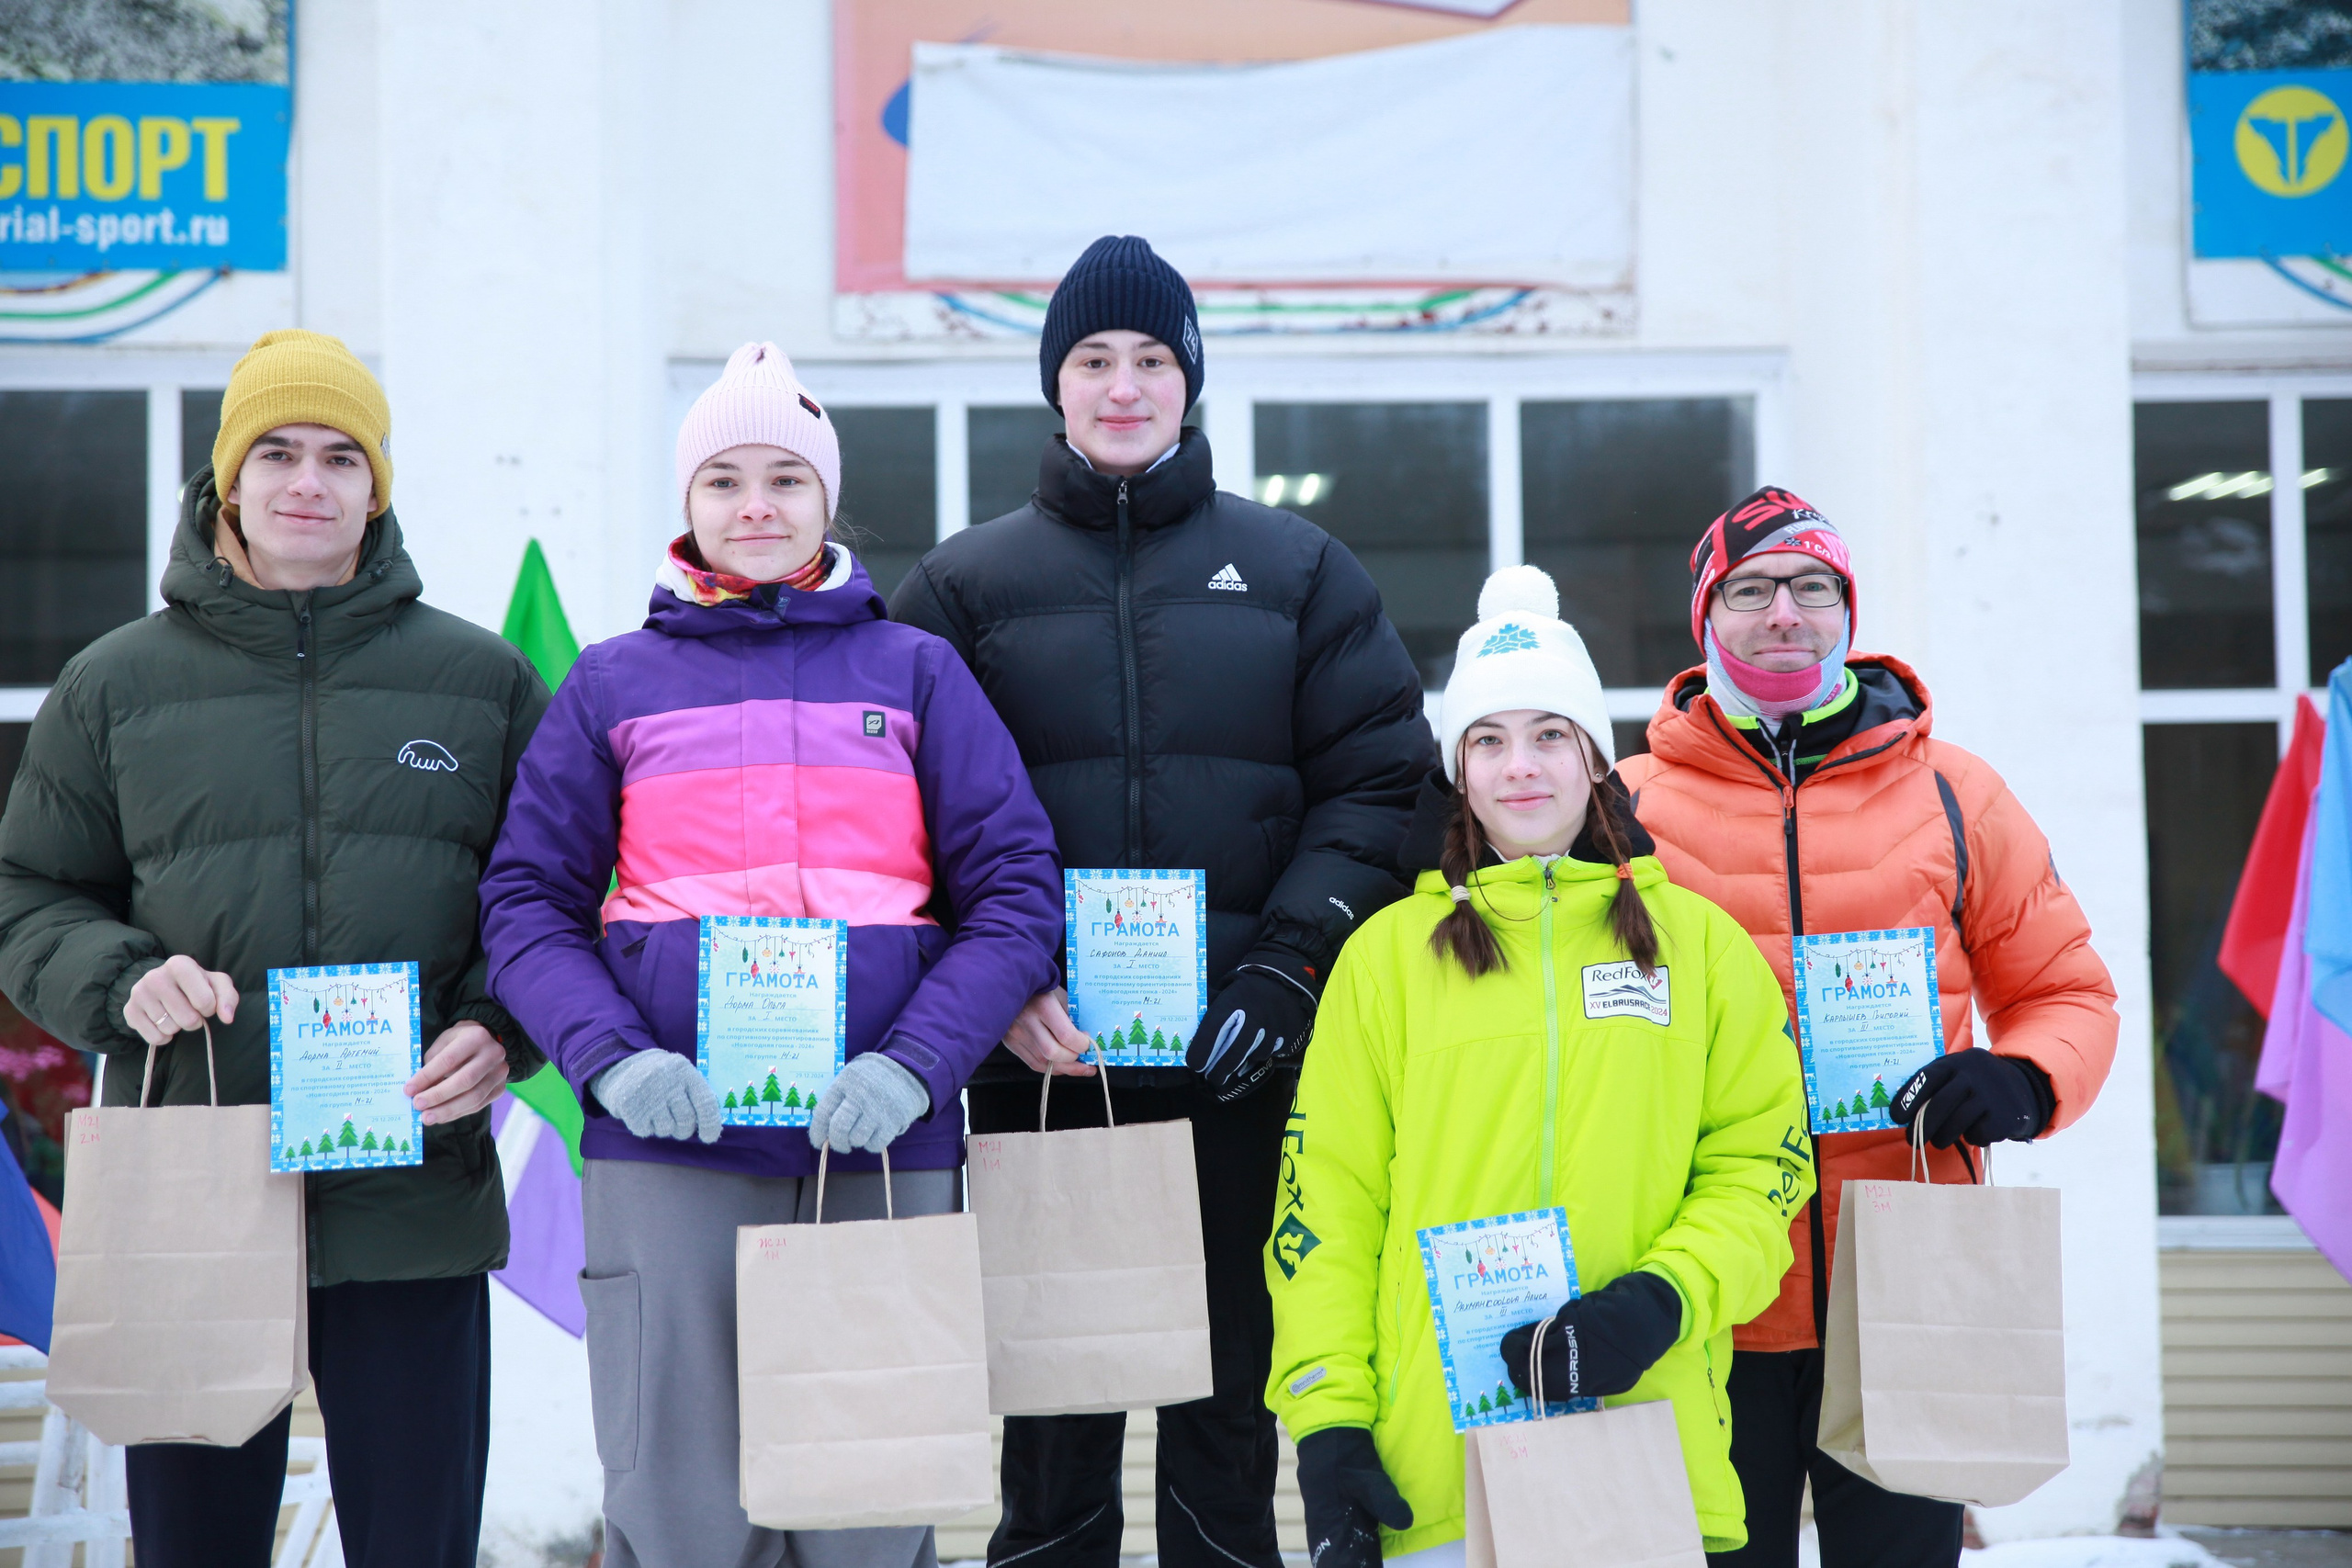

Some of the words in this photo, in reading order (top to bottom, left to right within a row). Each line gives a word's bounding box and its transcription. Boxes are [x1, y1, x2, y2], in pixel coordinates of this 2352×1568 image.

[1208, 581, 1248, 592] adidas
[1329, 897, 1354, 919] adidas
[1091, 922, 1180, 936] ГРАМОТА
[726, 973, 819, 988] ГРАМОТА
[1822, 983, 1911, 1002] ГРАМОТА
[1651, 1006, 1668, 1016] 2024
[299, 1020, 392, 1038] ГРАМОТА
[1454, 1264, 1548, 1290] ГРАМОТА
[1481, 1286, 1528, 1295] Награждается
[1565, 1325, 1578, 1393] NORDSKI
